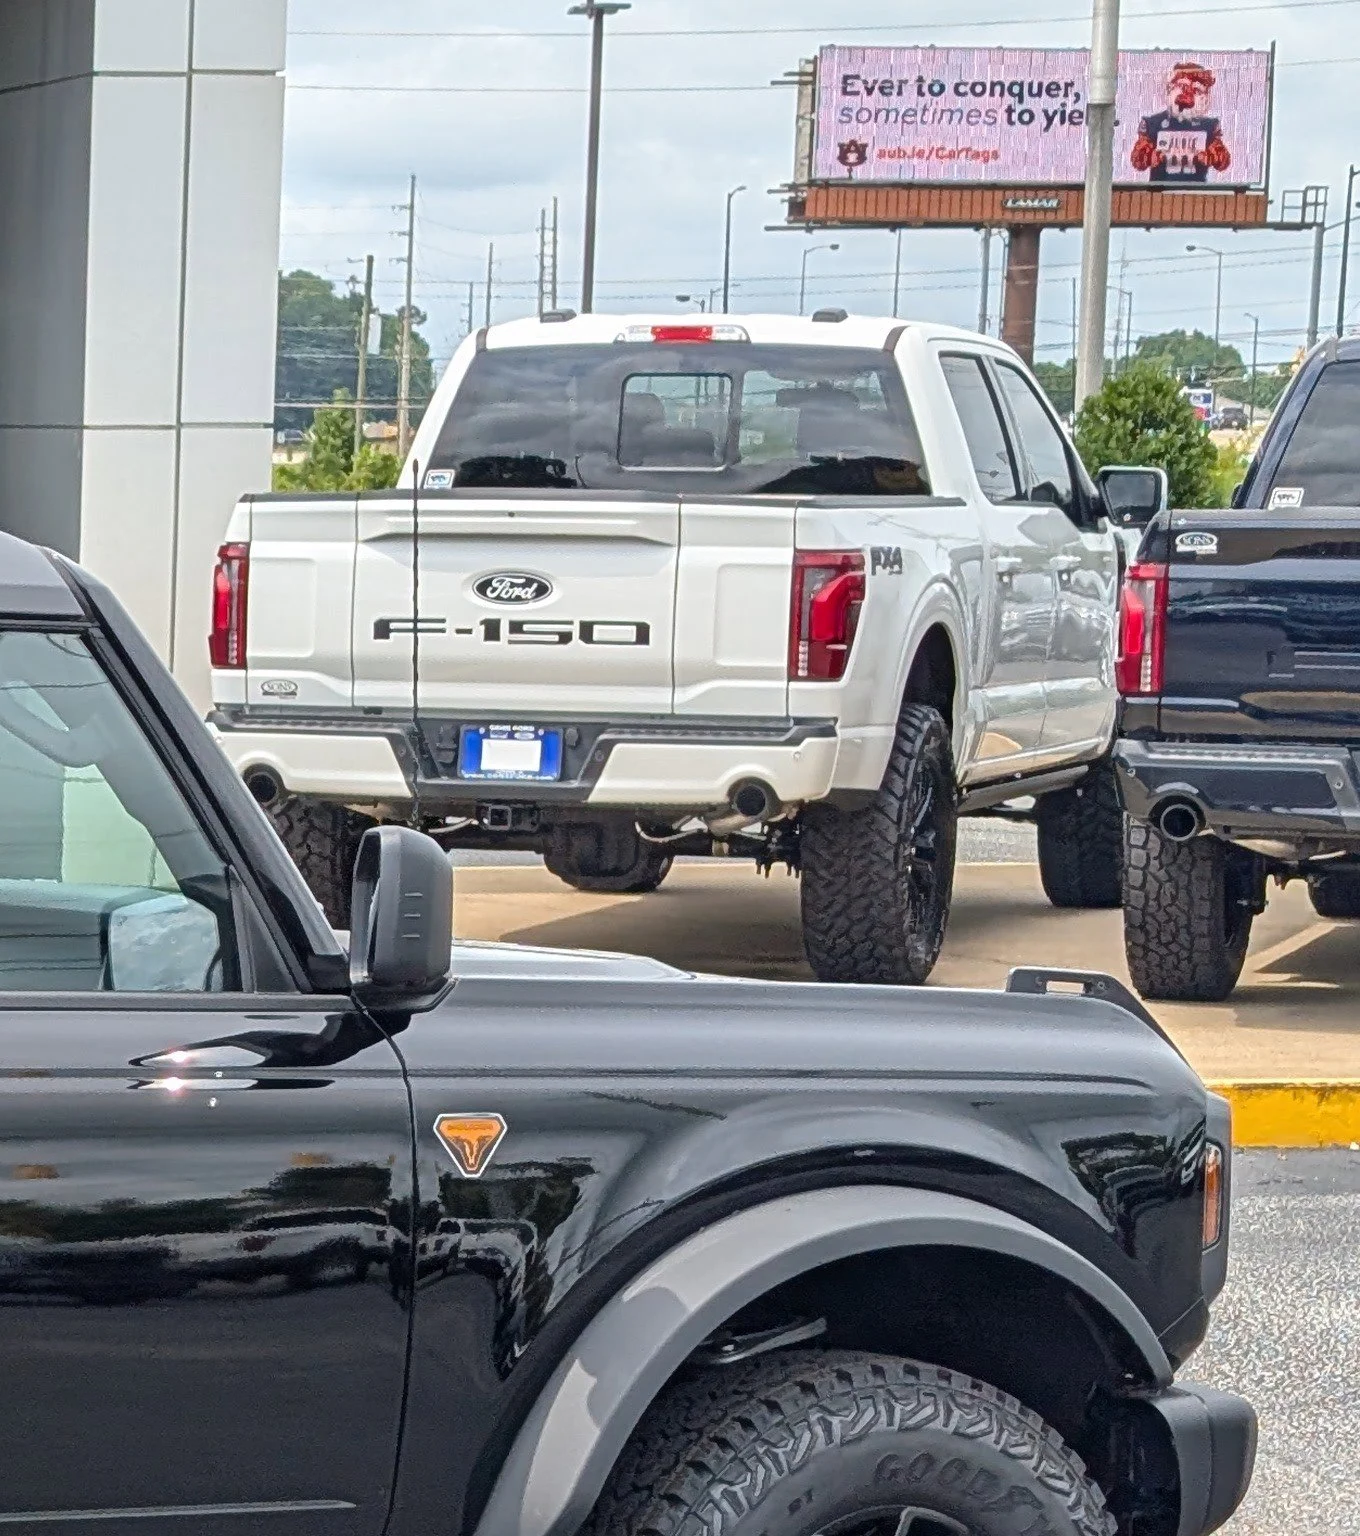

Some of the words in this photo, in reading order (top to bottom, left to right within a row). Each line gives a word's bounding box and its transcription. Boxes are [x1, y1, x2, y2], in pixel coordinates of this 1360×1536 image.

[841, 74, 909, 97] Ever
[916, 75, 946, 98] to
[953, 79, 1081, 105] conquer,
[838, 103, 998, 126] sometimes
[1005, 103, 1036, 126] to
[870, 546, 903, 576] FX4
[486, 576, 538, 600] Ford
[373, 617, 651, 646] F-150
